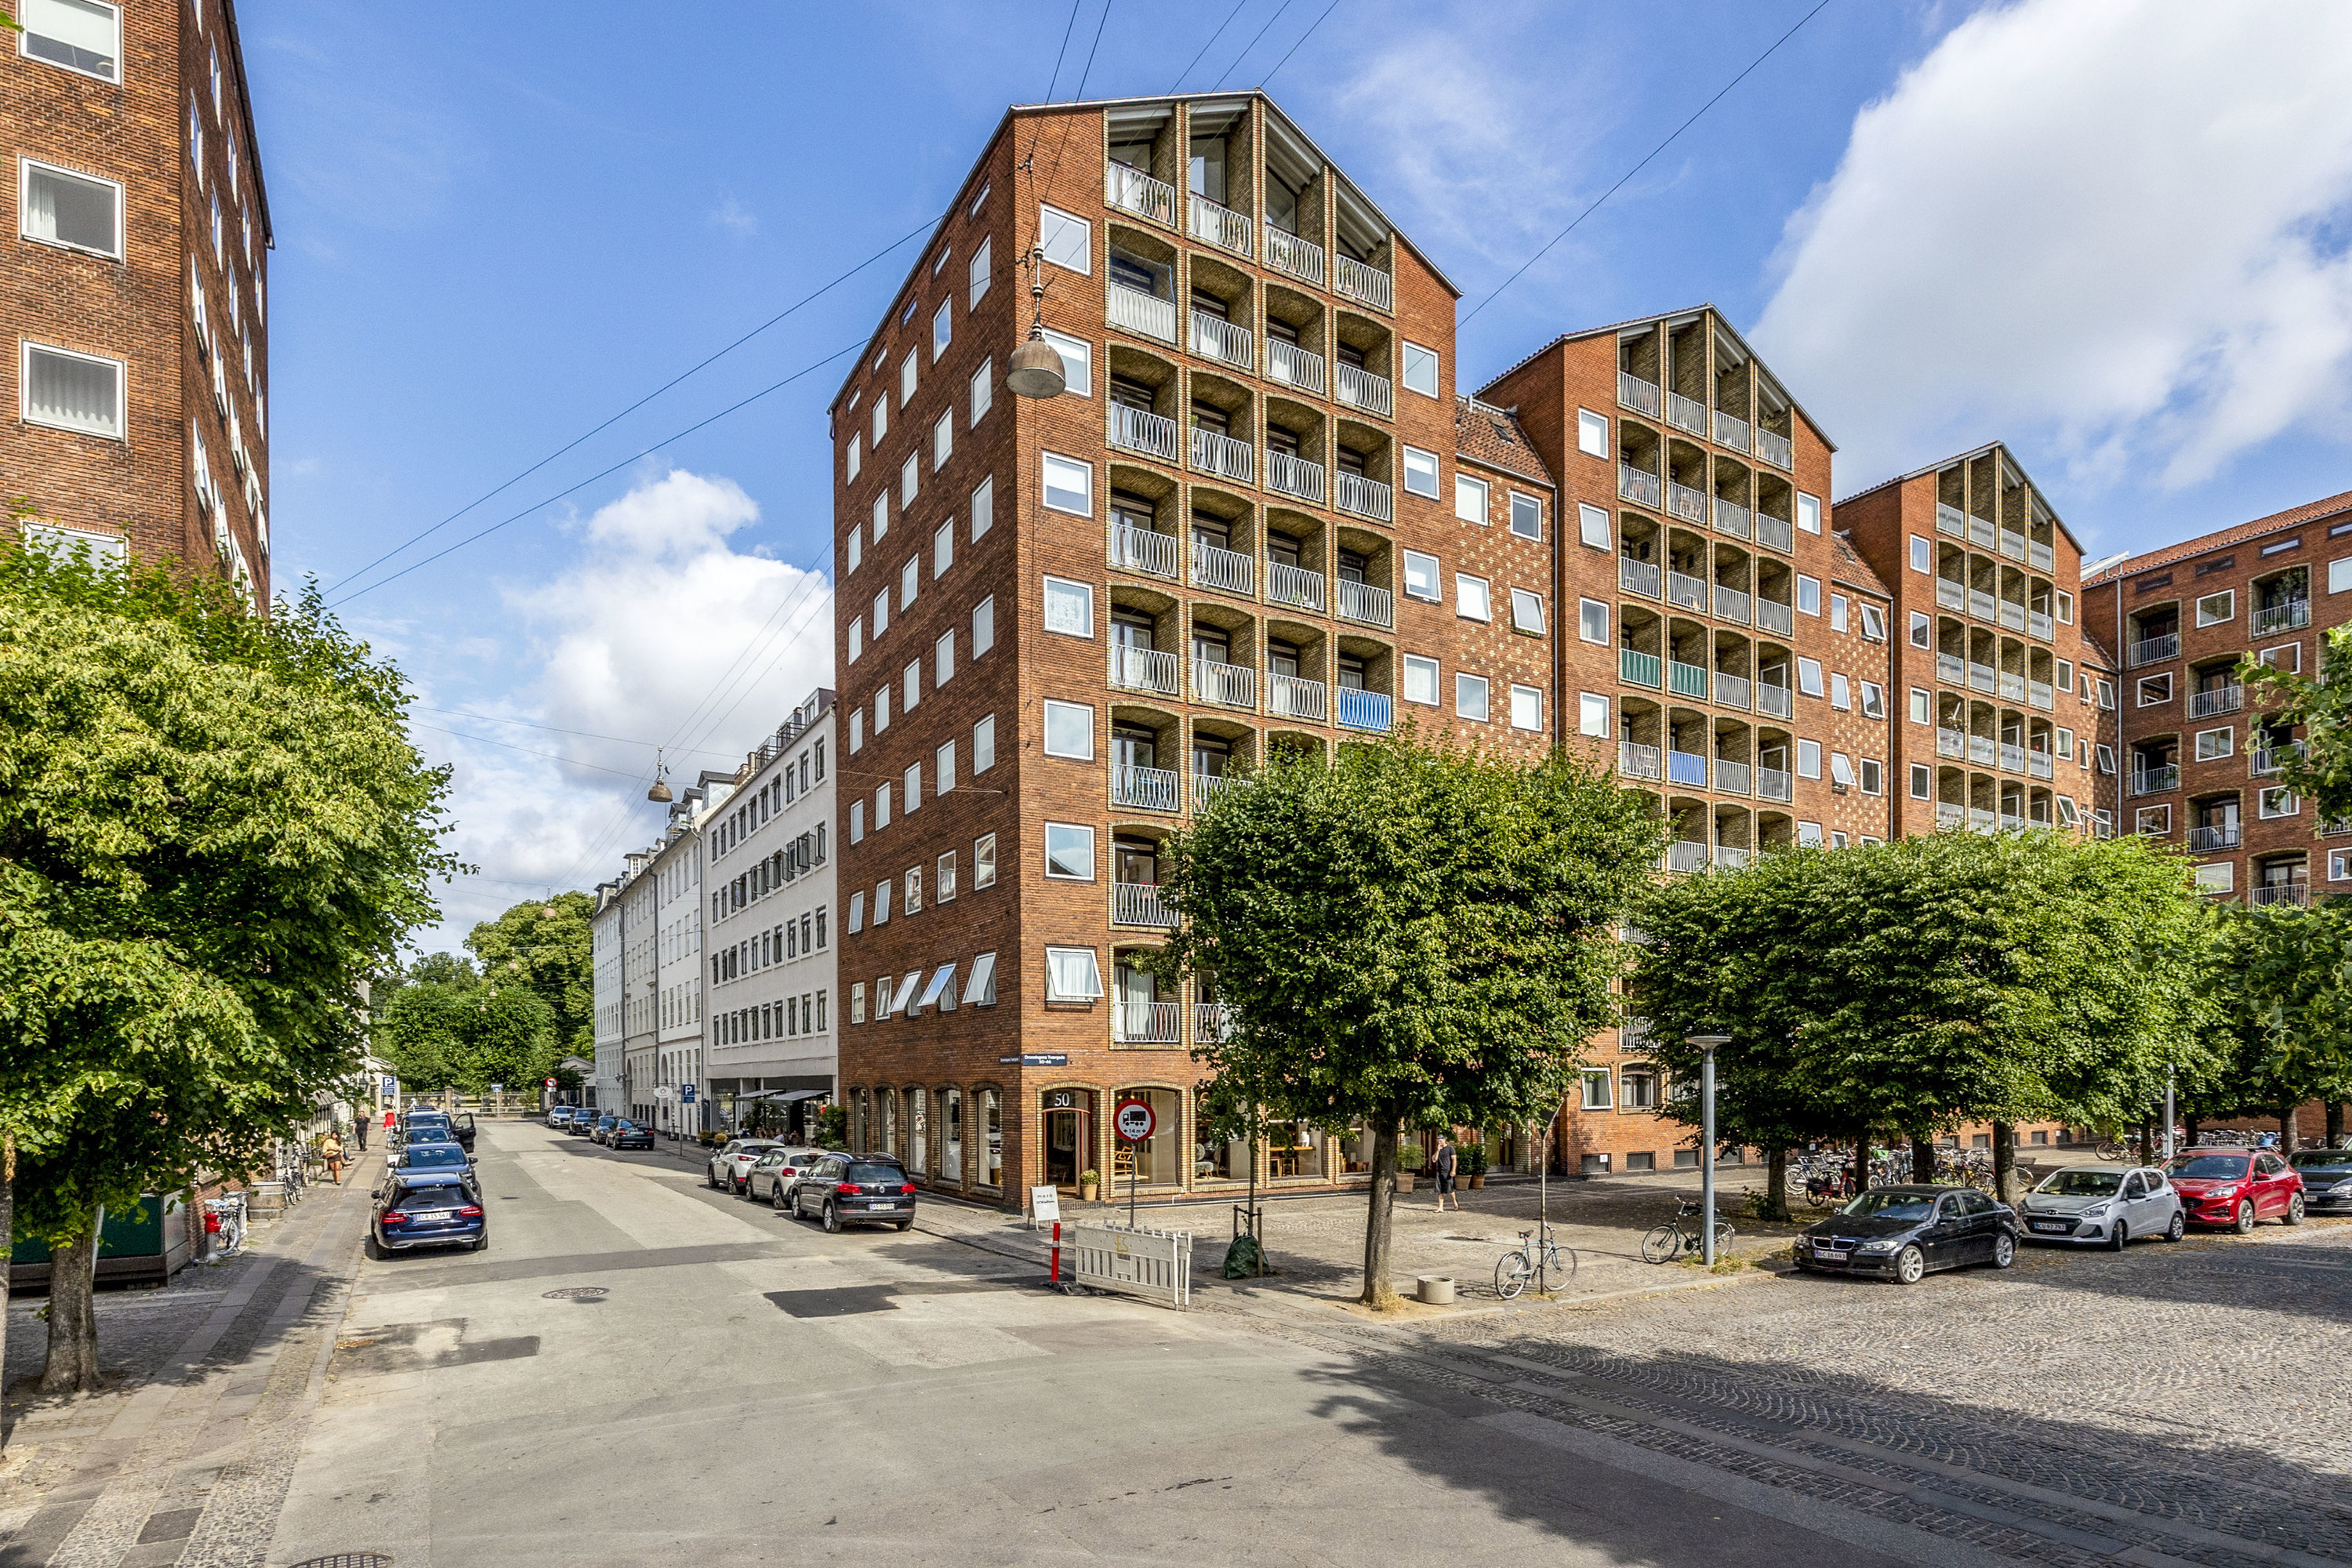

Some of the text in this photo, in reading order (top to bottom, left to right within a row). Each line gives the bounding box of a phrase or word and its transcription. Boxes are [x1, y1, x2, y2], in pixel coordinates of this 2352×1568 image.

[384, 1077, 393, 1087] P
[685, 1086, 692, 1095] P
[1054, 1092, 1069, 1106] 50
